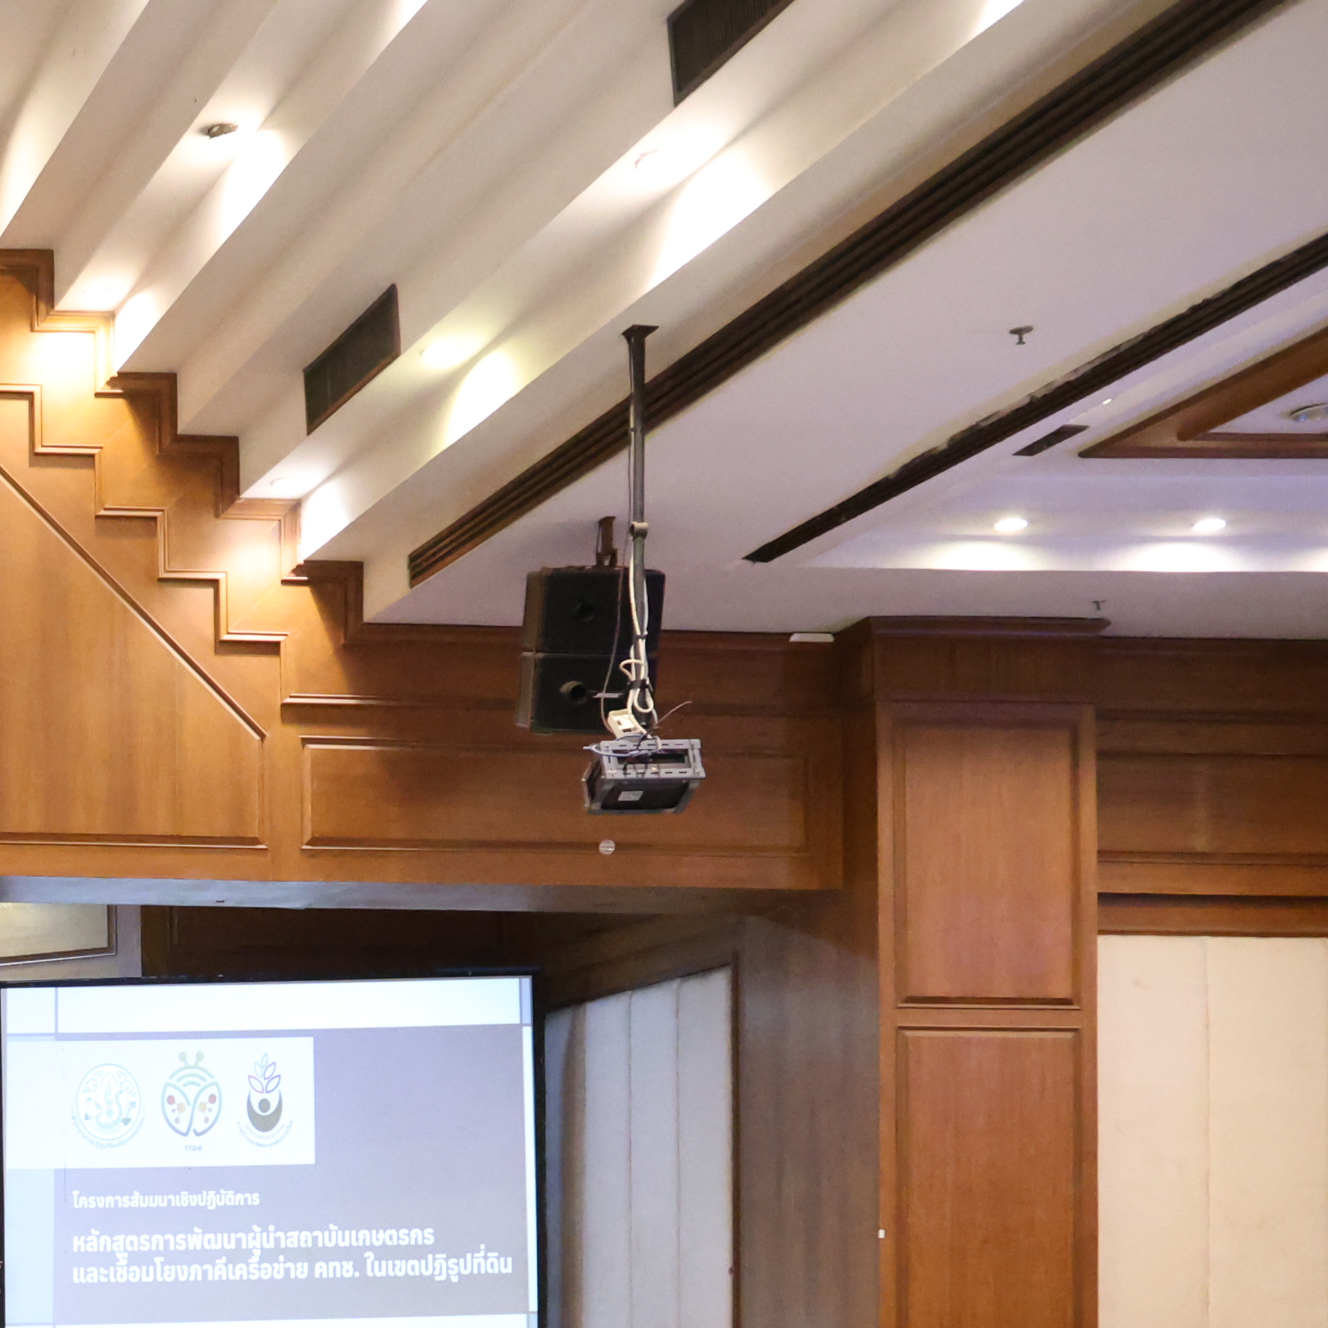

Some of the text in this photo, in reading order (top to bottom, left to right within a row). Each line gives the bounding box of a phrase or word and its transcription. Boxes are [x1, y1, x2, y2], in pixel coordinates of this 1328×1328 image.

[72, 1189, 261, 1210] โครงการสัมมนาเชิงปฏิบัติการ
[73, 1224, 435, 1257] หลักสูตรการพัฒนาผู้นำสถาบันเกษตรกร
[73, 1244, 513, 1284] และเชื่อมโยงภาคีเครือข่าย คทช. ในเขตปฏิรูปที่ดิน
